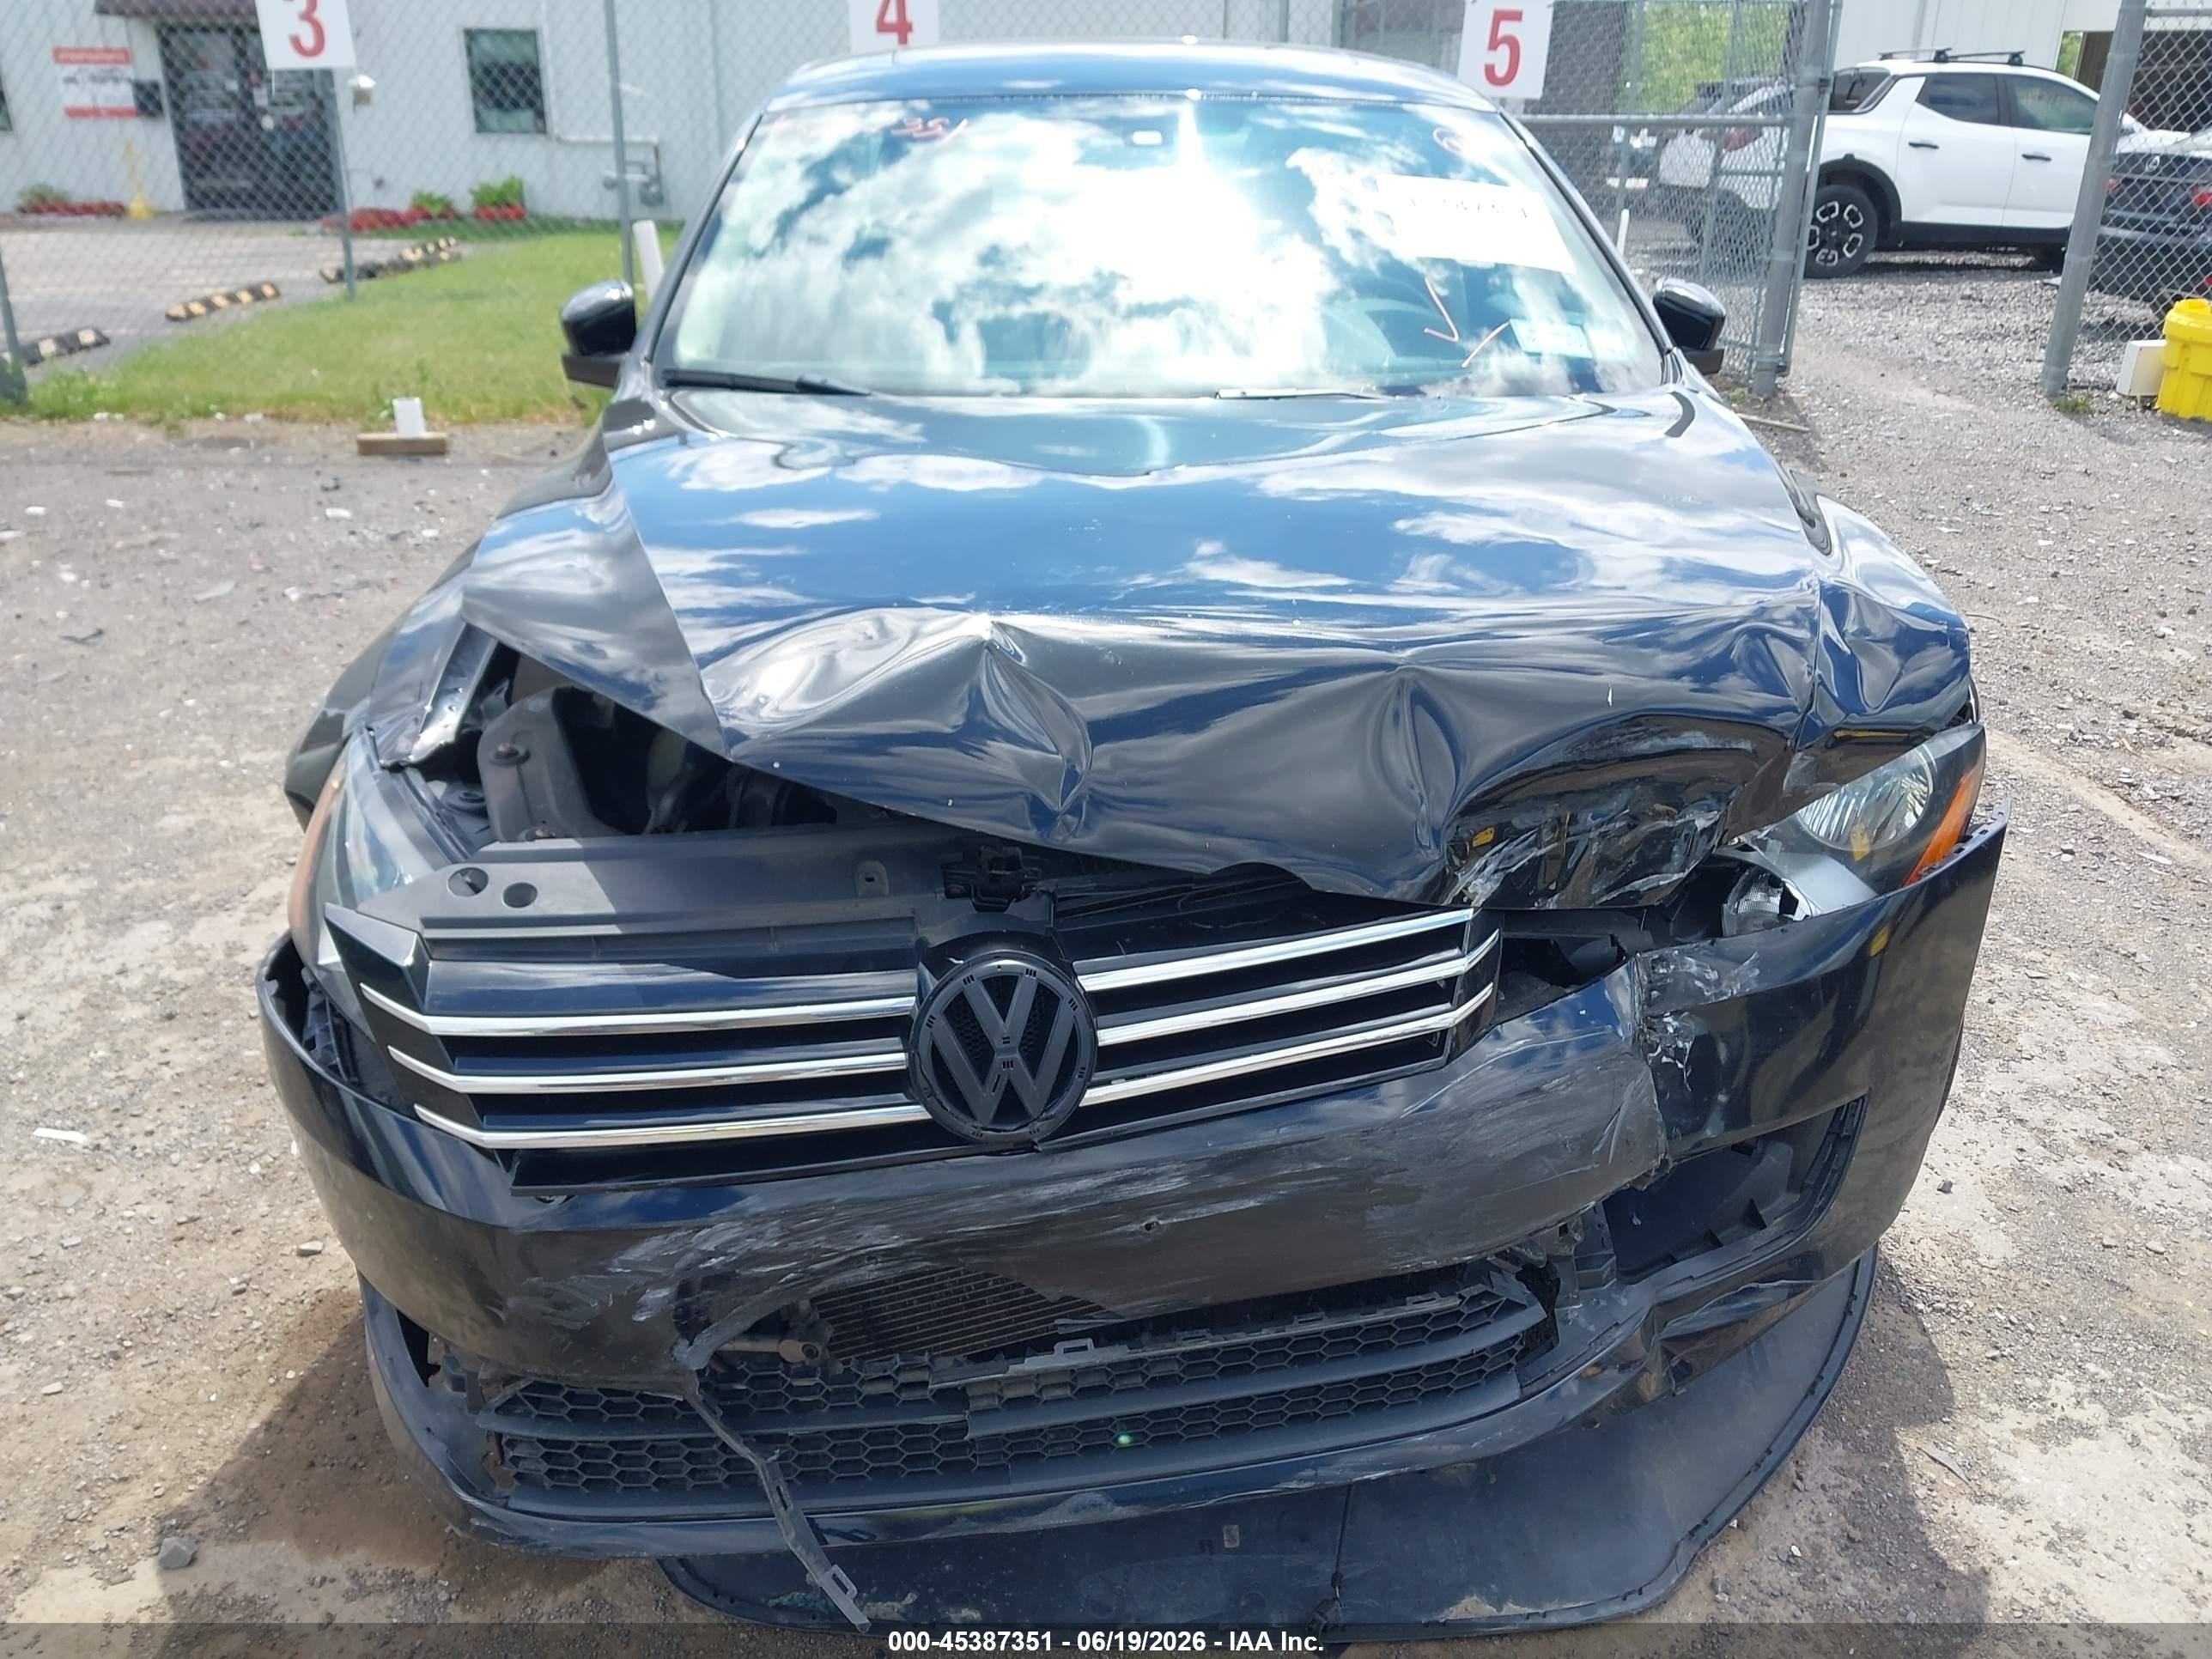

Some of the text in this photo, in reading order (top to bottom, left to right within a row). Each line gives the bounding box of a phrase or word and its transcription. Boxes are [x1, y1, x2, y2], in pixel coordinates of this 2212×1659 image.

[288, 0, 325, 58] 3
[876, 0, 913, 46] 4
[1485, 9, 1523, 87] 5
